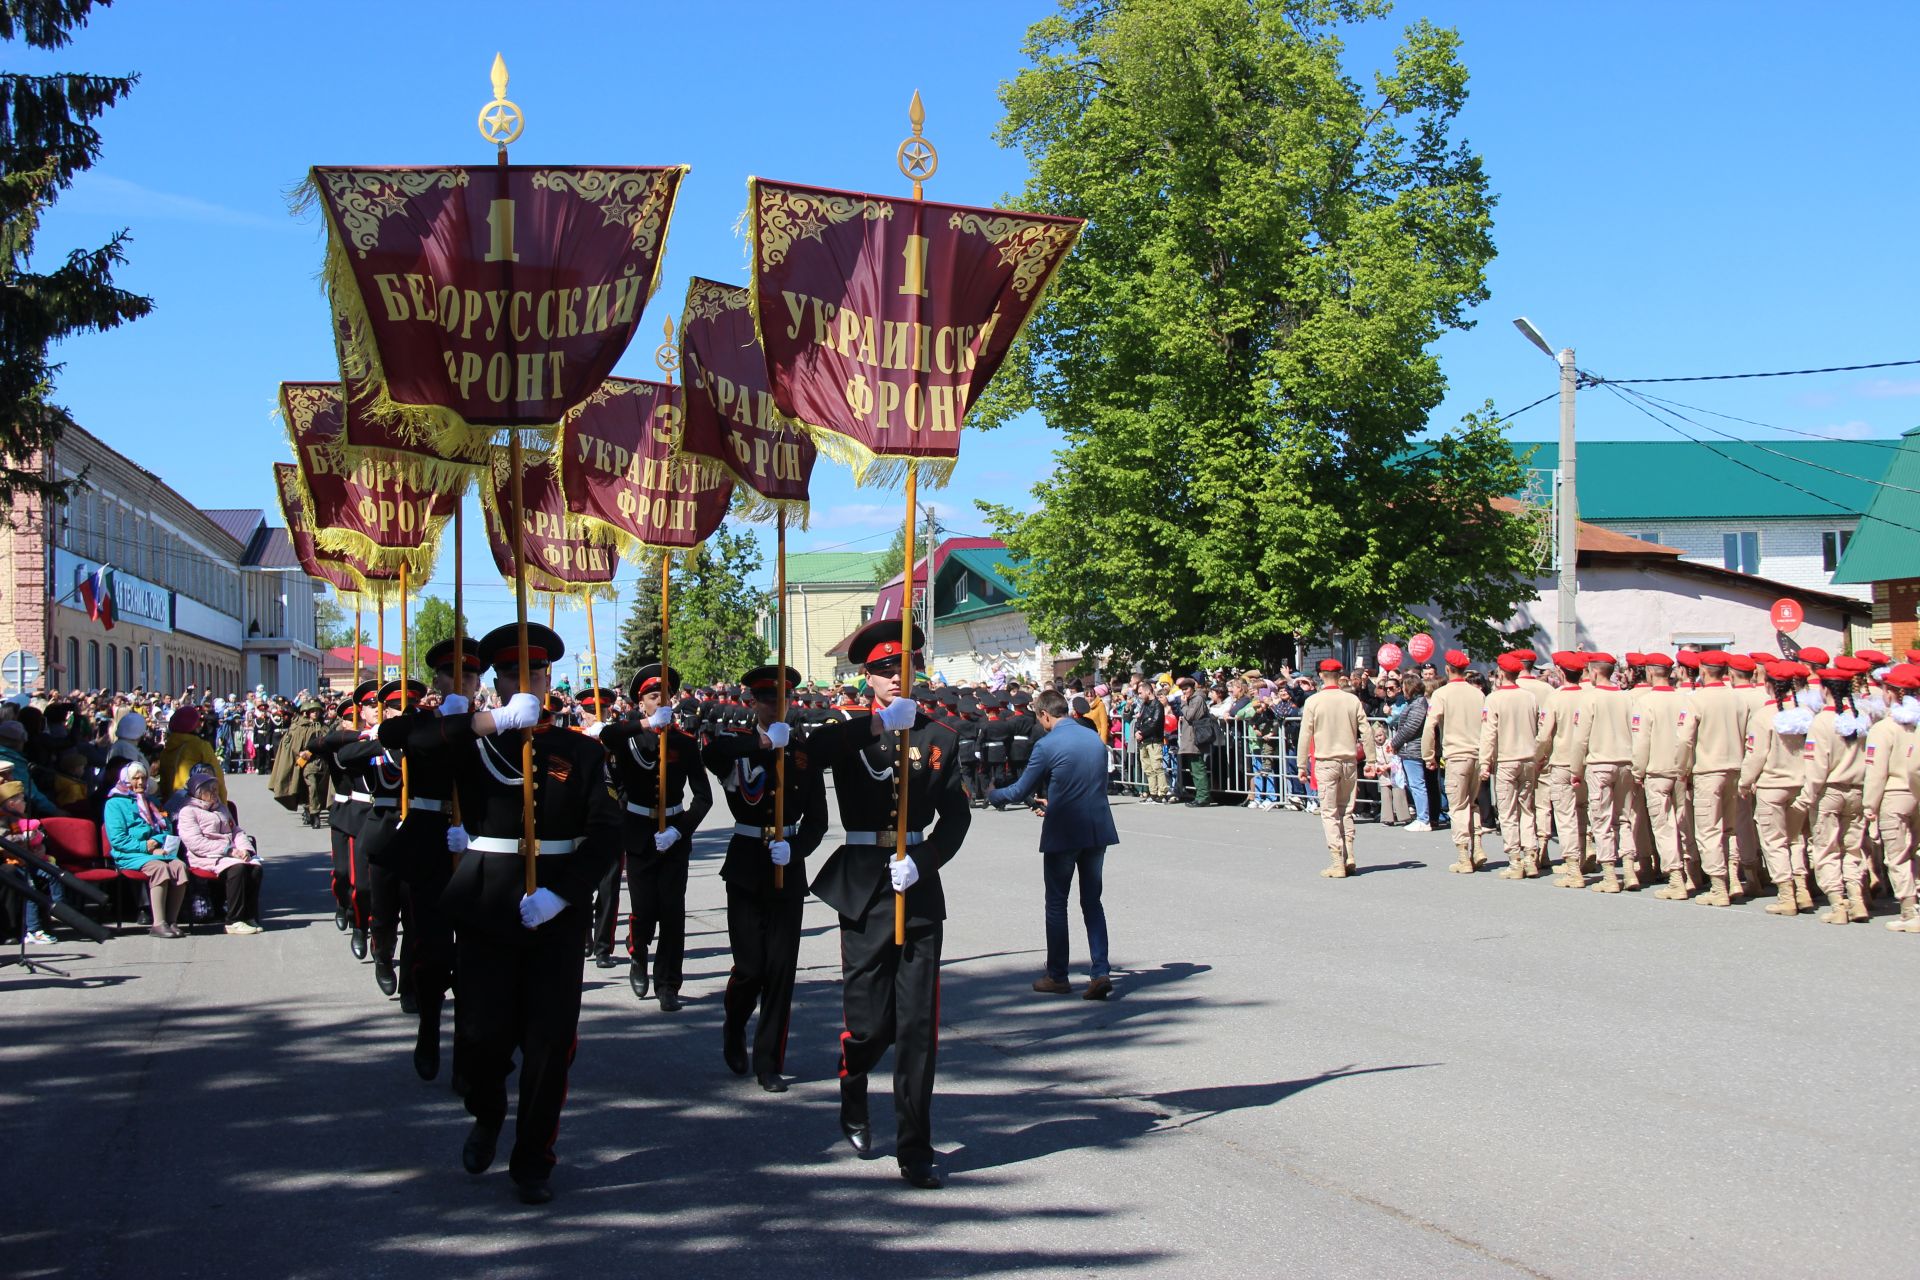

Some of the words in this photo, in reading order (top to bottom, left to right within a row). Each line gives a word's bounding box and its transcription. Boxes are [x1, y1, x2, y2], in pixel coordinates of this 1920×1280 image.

[484, 199, 519, 262] 1
[898, 234, 931, 297] 1
[373, 263, 643, 342] БЕОРУССКИЙ
[653, 404, 682, 443] 3
[616, 488, 698, 530] ФРОНТ
